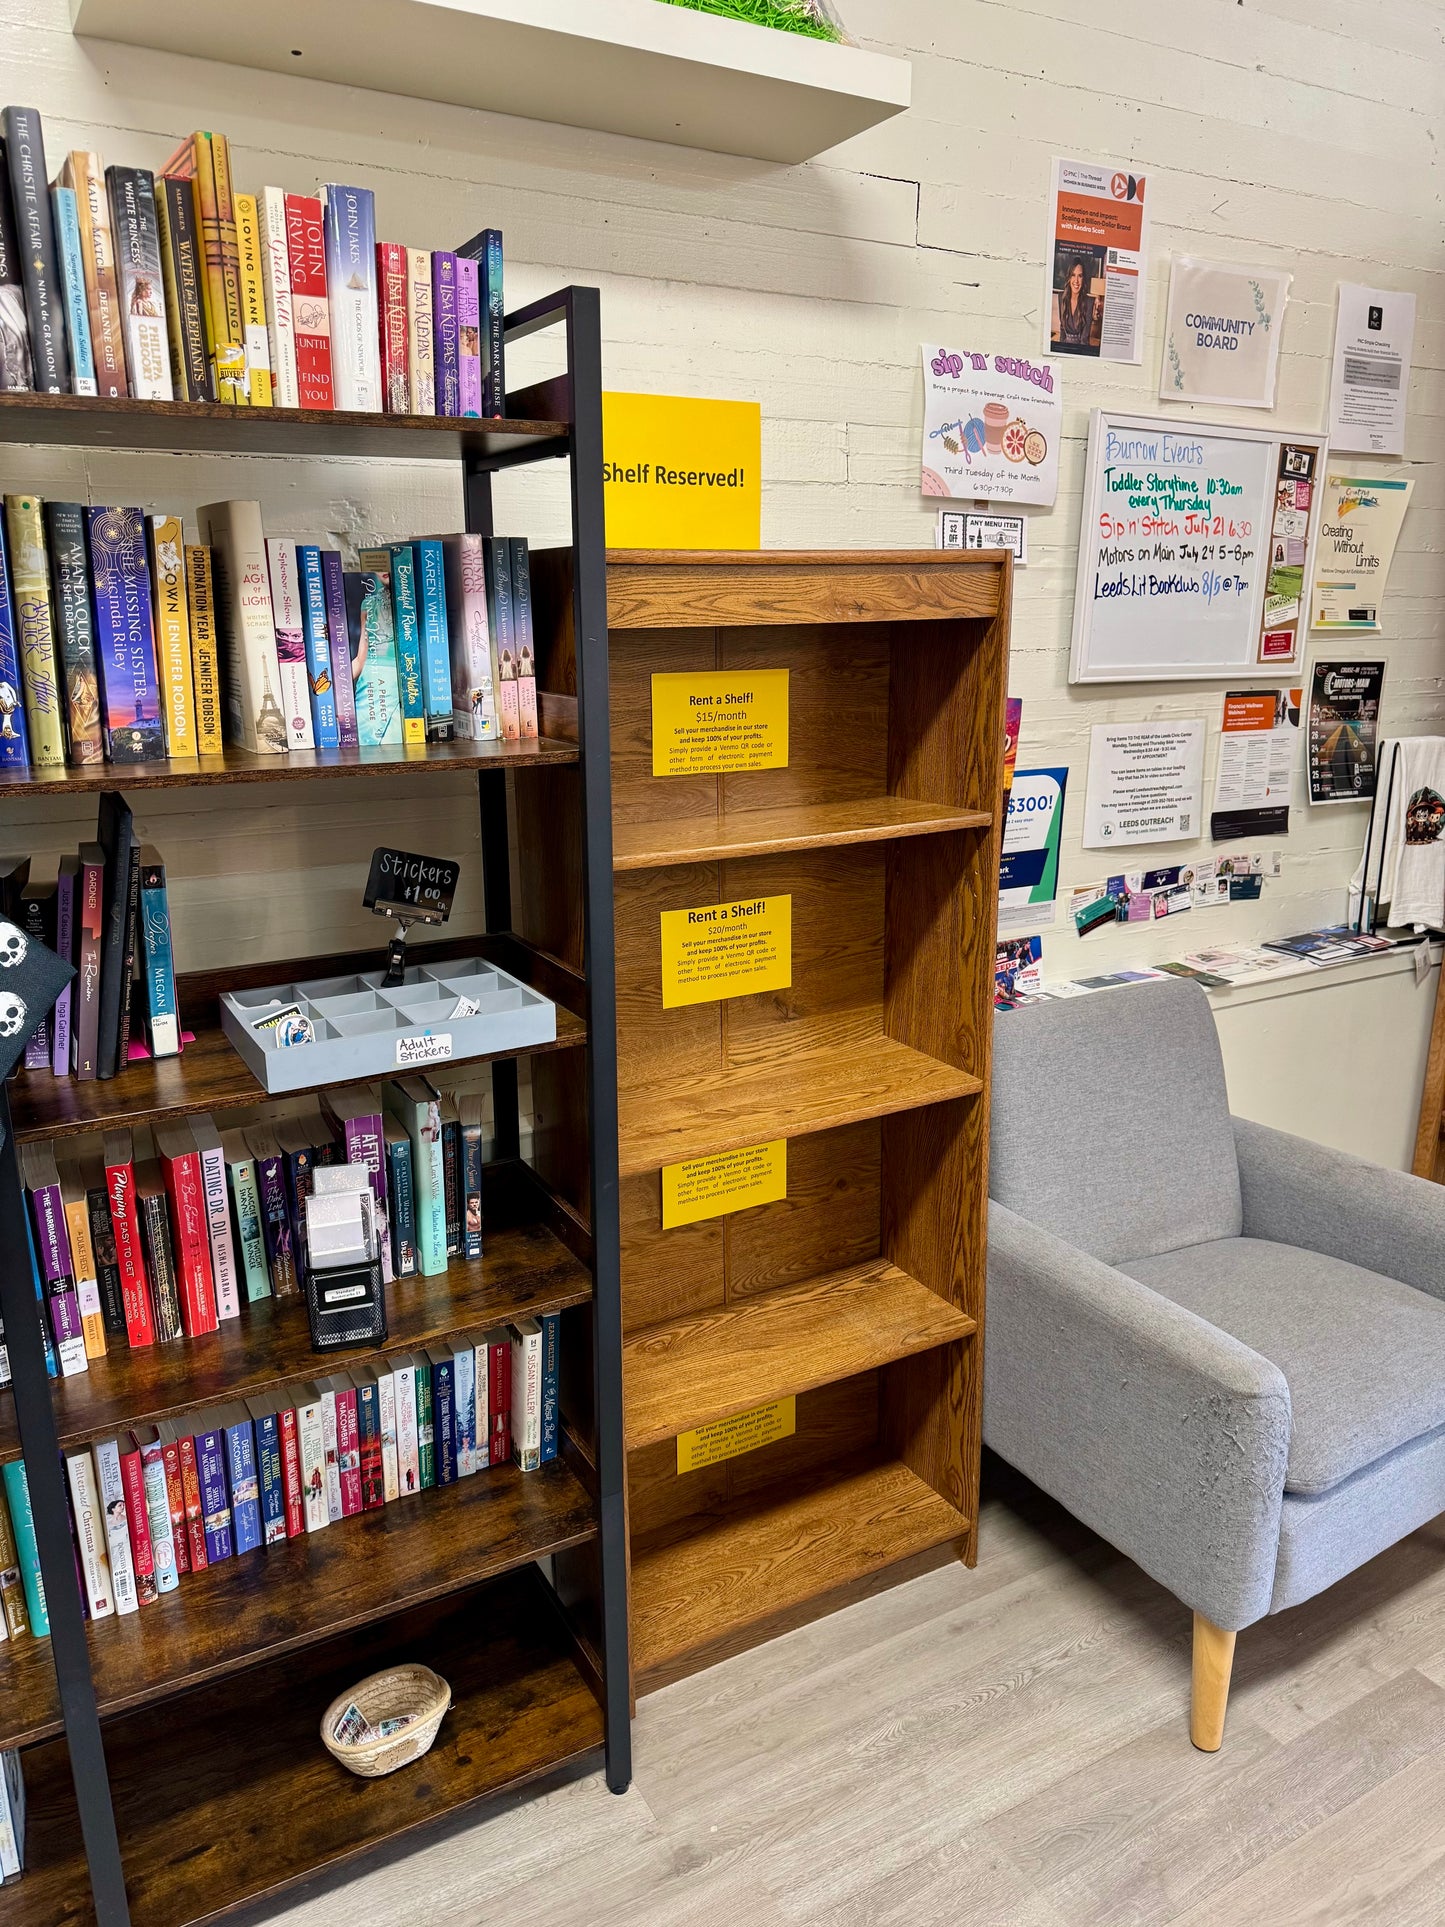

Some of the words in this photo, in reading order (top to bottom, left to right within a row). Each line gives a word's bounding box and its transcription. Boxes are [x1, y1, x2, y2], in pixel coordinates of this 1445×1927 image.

[16, 114, 30, 141] THE
[19, 143, 37, 205] CHRISTIE
[124, 182, 136, 216] WHITE
[346, 193, 358, 231] JOHN
[1062, 206, 1088, 215] Innovation
[27, 209, 42, 249] AFFAIR
[127, 218, 141, 263] PRINCESS
[1074, 224, 1091, 232] Kendra
[242, 219, 255, 271] LOVING
[288, 208, 307, 283] IRVING
[305, 219, 323, 276] JOHN
[348, 232, 360, 264] JAKES
[37, 280, 50, 309] NINA
[247, 280, 259, 325] FRANK
[413, 282, 430, 309] LISA
[42, 311, 49, 322] de
[98, 292, 112, 342] DEEANNE
[1185, 313, 1255, 336] COMMUNITY
[300, 338, 328, 350] UNTIL
[414, 310, 432, 360] KLEYPAS
[1196, 333, 1239, 351] BOARD
[43, 324, 57, 379] GRAMONT
[103, 345, 115, 370] GIST
[312, 357, 316, 366] I
[302, 373, 330, 384] FIND
[494, 371, 500, 382] WE
[931, 349, 963, 378] sip
[995, 356, 1054, 393] stitch
[305, 389, 328, 401] YOU
[1106, 432, 1158, 461] Burrow
[1163, 435, 1203, 465] Events
[602, 462, 650, 483] Shelf
[656, 465, 744, 488] Reserved!
[966, 469, 994, 481] Tuesday
[997, 470, 1005, 478] of
[1021, 474, 1040, 482] Month
[1104, 467, 1144, 493] Toddler
[1147, 473, 1199, 499] Storytime
[1207, 478, 1243, 495] 10:30am
[1128, 496, 1159, 517] every
[1159, 495, 1211, 521] Thursday
[949, 534, 958, 542] OFF
[1100, 513, 1124, 541] Sip
[1142, 515, 1179, 536] Stitch
[1184, 514, 1209, 538] July
[1213, 516, 1224, 536] 21
[1229, 520, 1251, 538] 6:30
[1322, 524, 1353, 541] Creating
[121, 541, 135, 569] THE
[1098, 547, 1134, 567] Motors
[1138, 549, 1150, 560] on
[1153, 542, 1175, 563] Main
[1180, 544, 1198, 563] July
[1202, 546, 1214, 560] 24
[1219, 545, 1254, 565] 5-8pm
[1334, 540, 1364, 553] Without
[59, 553, 70, 581] WHEN
[70, 541, 87, 605] AMANDA
[306, 552, 319, 573] FIVE
[424, 550, 437, 597] KAREN
[462, 549, 475, 594] WIGGS
[471, 549, 485, 593] SUSAN
[1356, 555, 1379, 567] Limits
[62, 584, 72, 597] SHE
[192, 550, 208, 612] CORONATION
[243, 574, 265, 583] AGE
[309, 576, 323, 608] YEARS
[1095, 572, 1131, 600] Leeds
[1132, 575, 1146, 596] Lit
[1202, 570, 1221, 605] 8/5
[1223, 578, 1232, 591] @
[1234, 575, 1249, 595] 7pm
[107, 567, 122, 626] Lucinda
[124, 575, 142, 642] MISSING
[242, 596, 271, 606] LIGHT
[19, 602, 39, 658] QUICK
[32, 597, 52, 662] AMANDA
[64, 599, 75, 644] DREAMS
[76, 608, 91, 655] QUICK
[197, 615, 208, 640] YEAR
[312, 612, 325, 638] FROM
[427, 601, 440, 644] WHITE
[112, 630, 128, 671] Riley
[315, 640, 328, 663] NOW
[130, 647, 147, 697] SISTER
[198, 649, 213, 695] JENNIFER
[689, 695, 713, 706] Rent
[725, 692, 753, 704] Shelf!
[202, 697, 215, 735] ROBSON
[686, 726, 698, 735] your
[700, 725, 735, 733] merchandise
[696, 710, 746, 723] $15/month
[1007, 795, 1053, 814] $300!
[1120, 820, 1139, 828] LEEDS
[1140, 817, 1174, 826] OUTREACH
[380, 854, 452, 884] Stickers
[89, 871, 97, 909] GARDNER
[404, 886, 440, 902] $1.00
[688, 910, 717, 924] Rent
[721, 910, 727, 919] a
[732, 901, 765, 918] Shelf!
[708, 922, 748, 935] $20/month
[155, 968, 166, 1006] MEGAN
[58, 1002, 67, 1017] Inga
[58, 1019, 68, 1050] Gardner
[400, 1037, 436, 1051] Adult
[84, 1062, 91, 1071] 1
[361, 1133, 380, 1174] AFTER
[204, 1156, 219, 1198] DATING
[110, 1170, 127, 1220] Playing
[211, 1201, 220, 1220] DR.
[119, 1221, 130, 1243] EASY
[211, 1221, 225, 1240] DIL
[123, 1246, 131, 1257] TO
[218, 1242, 226, 1263] NISHA
[125, 1259, 134, 1278] GET
[219, 1266, 229, 1298] SHARMA
[528, 1355, 536, 1380] SUSAN
[527, 1384, 535, 1416] MALLERY
[128, 1459, 139, 1493] DEBBIE
[130, 1494, 143, 1536] MACOMBER
